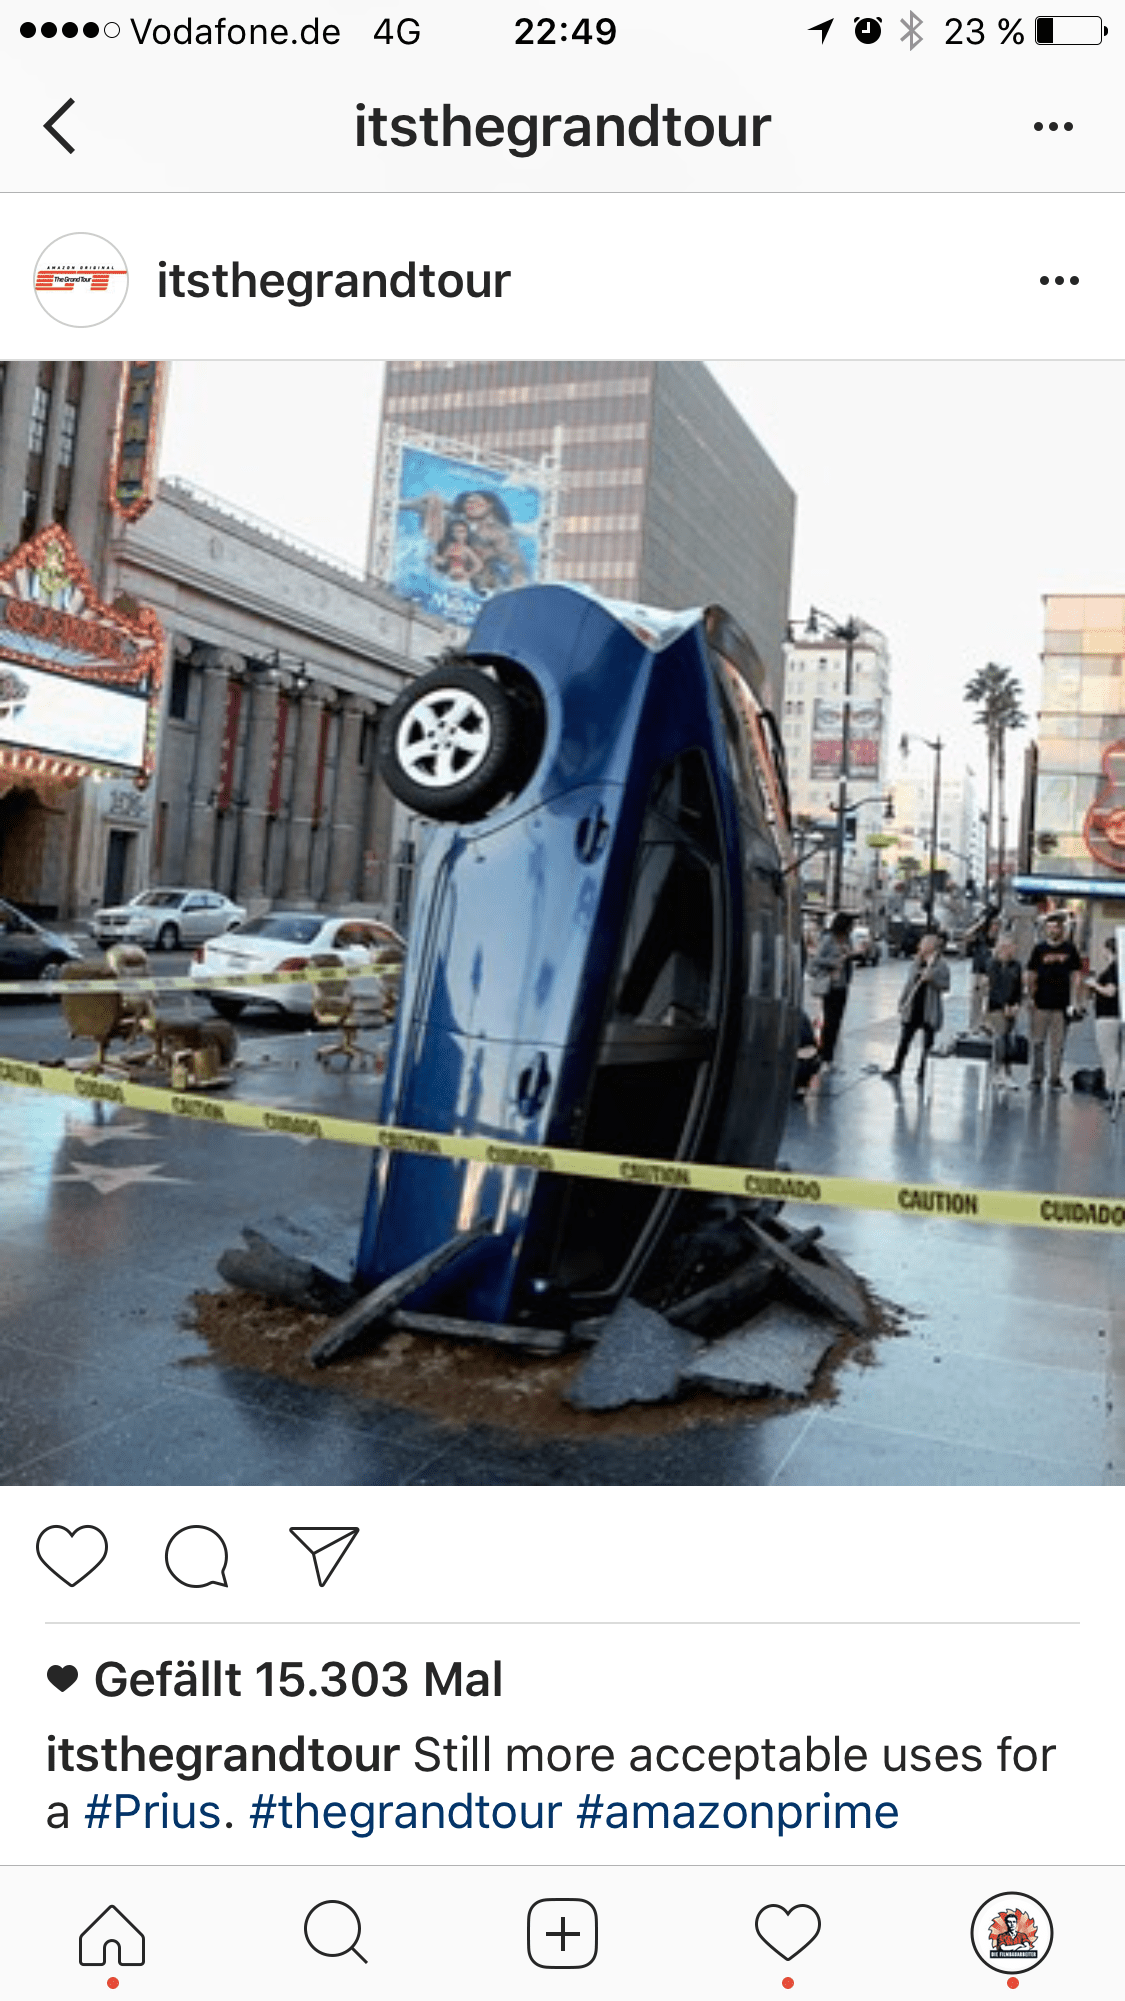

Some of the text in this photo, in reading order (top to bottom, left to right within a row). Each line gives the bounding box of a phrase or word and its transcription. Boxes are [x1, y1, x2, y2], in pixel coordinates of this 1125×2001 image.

[130, 16, 421, 46] Vodafone.de 4G
[514, 17, 617, 46] 22:49
[945, 17, 1025, 46] 23 %
[355, 102, 773, 159] itsthegrandtour
[158, 260, 512, 308] itsthegrandtour
[619, 1161, 692, 1186] CAUTION
[744, 1174, 822, 1201] CUIDADO
[897, 1187, 979, 1216] CAUTION
[1040, 1199, 1125, 1227] CUIDADO
[95, 1659, 502, 1698] Gefällt 15.303 Mal
[47, 1734, 1057, 1782] itsthegrandtour Still more acceptable uses for
[46, 1791, 899, 1839] a #Prius. #thegrandtour #amazonprime
